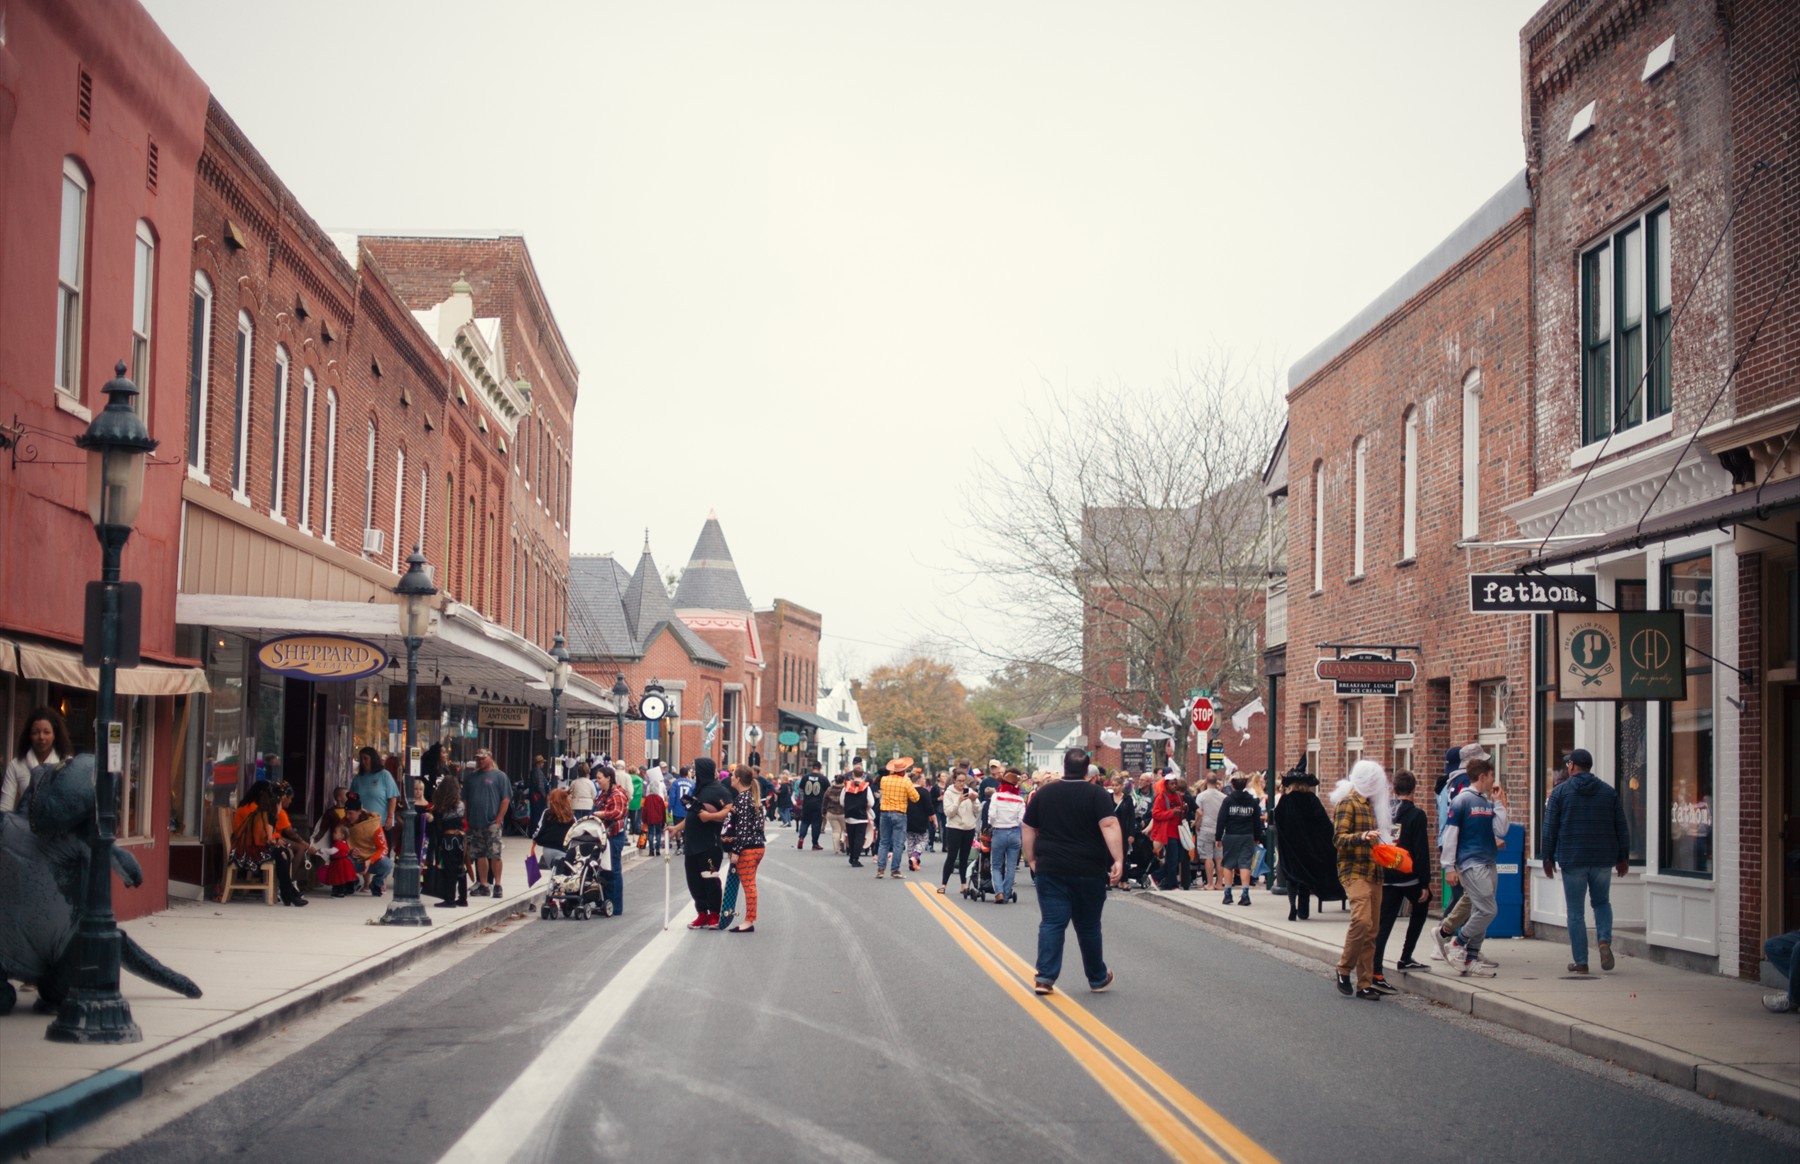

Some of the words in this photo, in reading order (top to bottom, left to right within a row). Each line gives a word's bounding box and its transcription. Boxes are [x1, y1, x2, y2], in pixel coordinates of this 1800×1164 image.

[1482, 581, 1587, 603] fathom.
[1570, 622, 1592, 637] BERLIN
[1594, 622, 1617, 650] PRINTERY
[271, 643, 370, 664] SHEPPARD
[315, 661, 358, 670] REALTY
[1324, 663, 1374, 675] RAYNE'S
[1377, 664, 1408, 675] REEF
[1193, 707, 1213, 721] STOP
[680, 786, 690, 799] 17
[805, 781, 821, 795] 00
